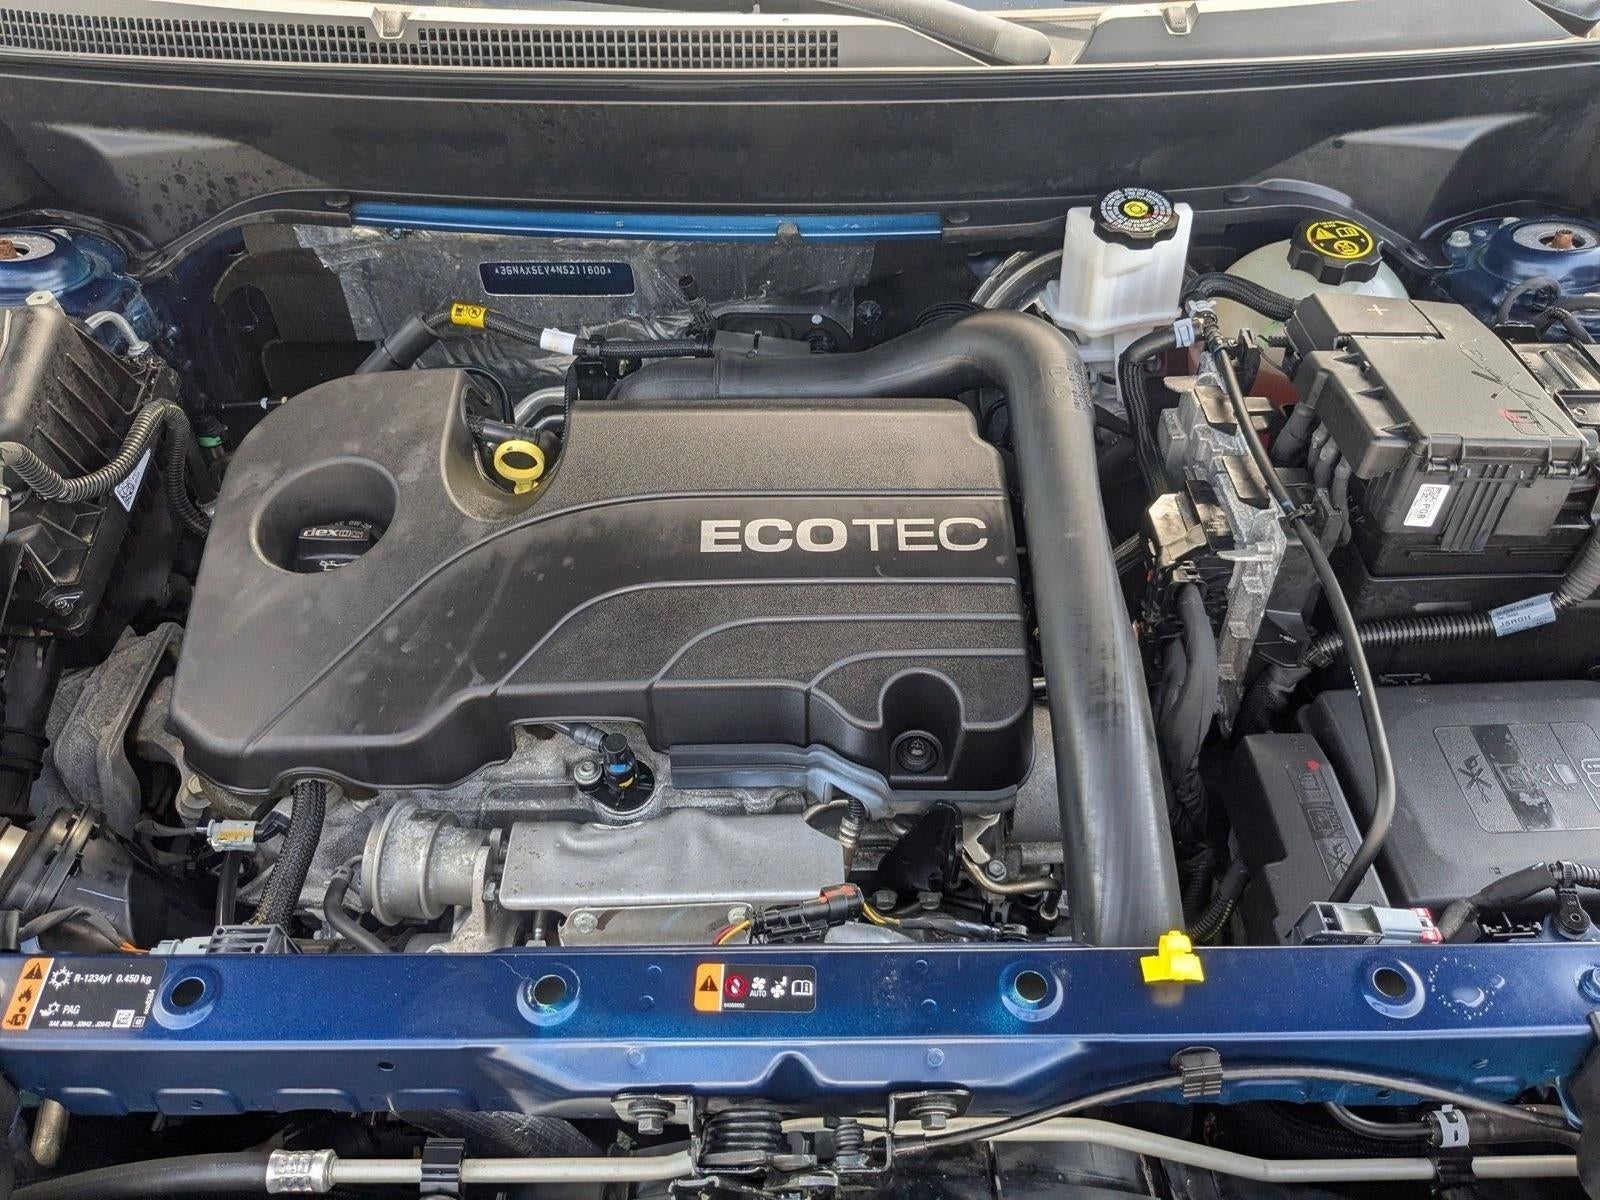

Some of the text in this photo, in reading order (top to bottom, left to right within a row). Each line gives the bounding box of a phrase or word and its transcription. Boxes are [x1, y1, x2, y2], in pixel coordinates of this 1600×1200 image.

[1416, 503, 1431, 519] PGB
[303, 527, 364, 539] dexos
[700, 517, 988, 552] ECOTEC
[73, 973, 152, 985] R-1234yf 0.450 kg
[749, 989, 767, 998] AUTO
[62, 1004, 81, 1014] PAG
